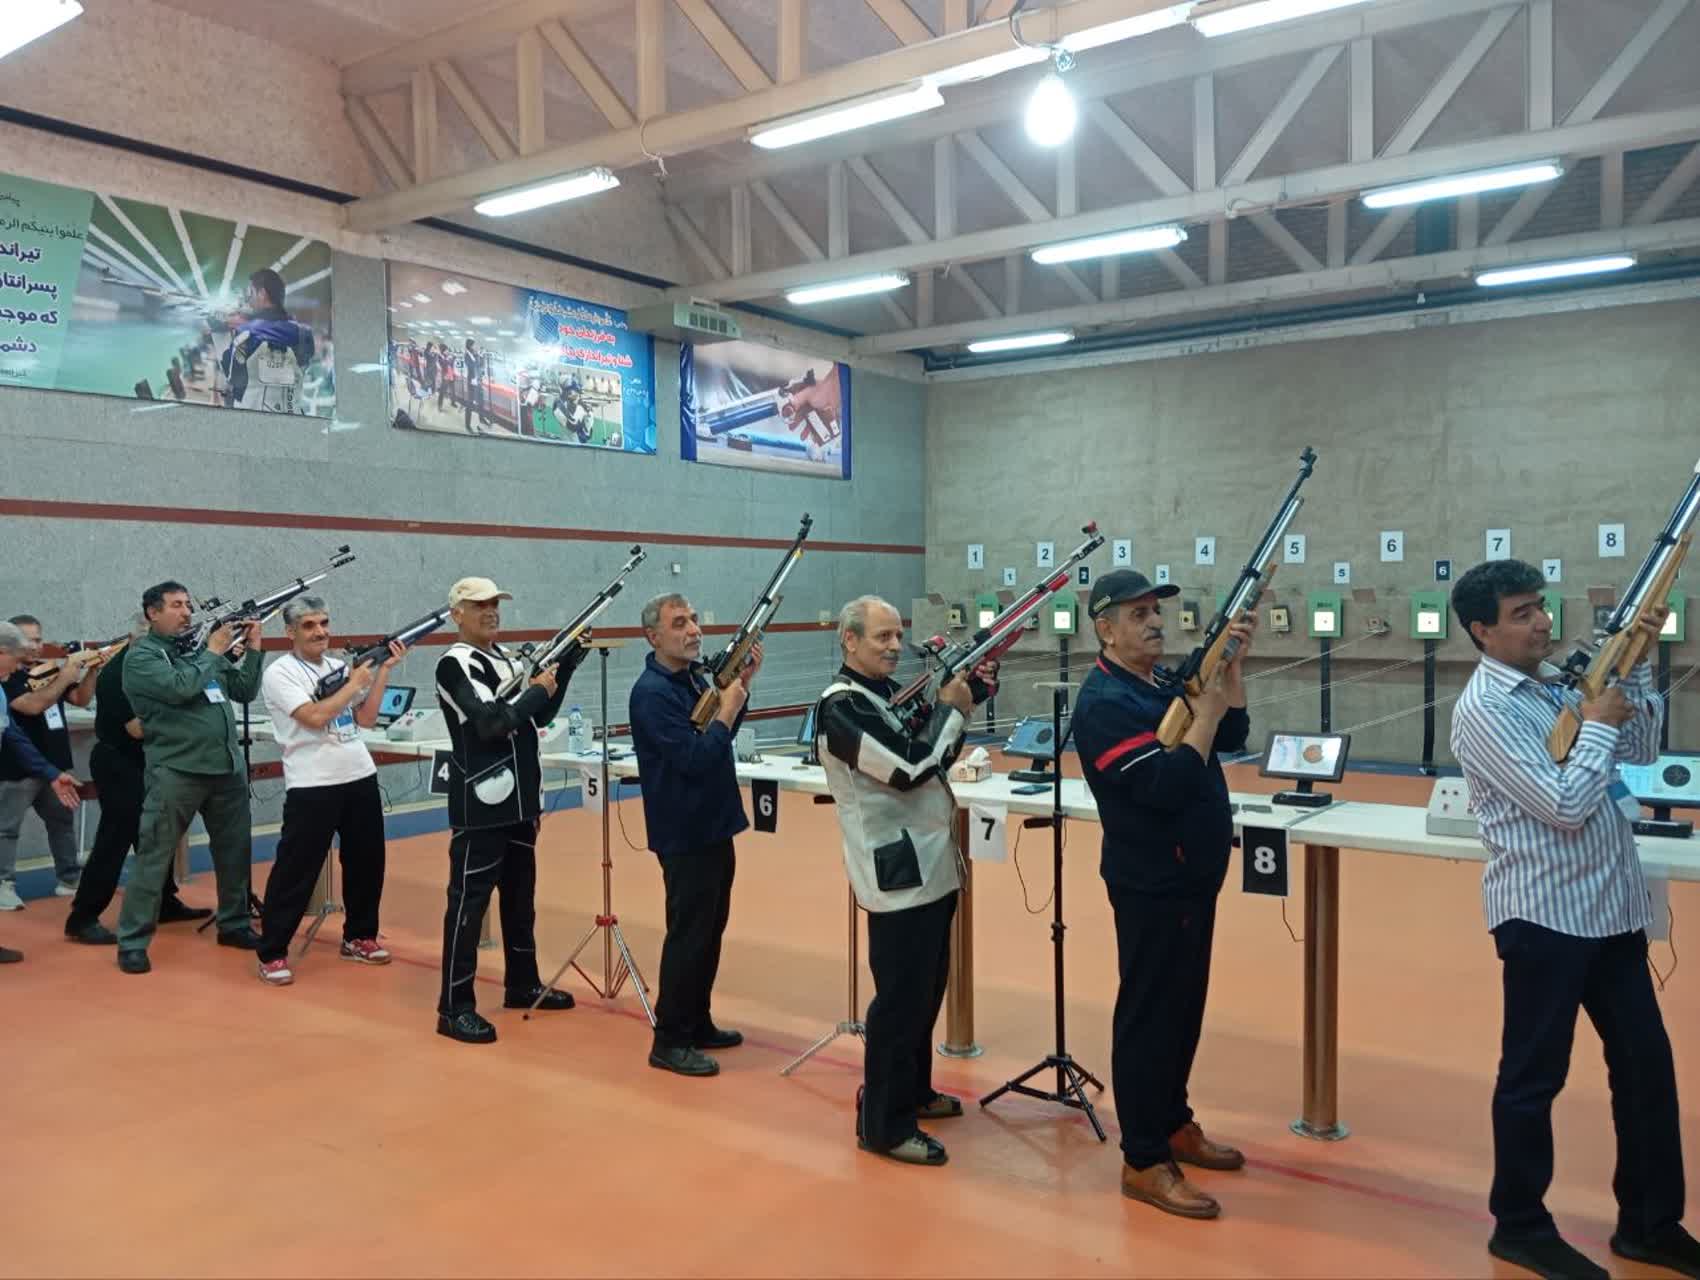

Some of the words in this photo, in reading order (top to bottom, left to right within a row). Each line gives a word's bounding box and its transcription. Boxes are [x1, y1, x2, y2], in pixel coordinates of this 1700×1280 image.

[40, 311, 57, 324] که
[1387, 538, 1397, 552] 6
[1492, 538, 1504, 552] 7
[1606, 533, 1616, 547] 8
[1042, 549, 1049, 560] 2
[1119, 546, 1126, 558] 3
[1200, 544, 1209, 556] 4
[1290, 542, 1299, 555] 5
[973, 551, 978, 562] 1
[1160, 570, 1166, 579] 3
[1338, 568, 1346, 577] 5
[1439, 566, 1447, 575] 6
[1547, 566, 1556, 576] 7
[438, 762, 450, 781] 4
[588, 778, 597, 796] 5
[759, 794, 773, 817] 6
[980, 818, 995, 841] 7
[1254, 846, 1276, 874] 8
